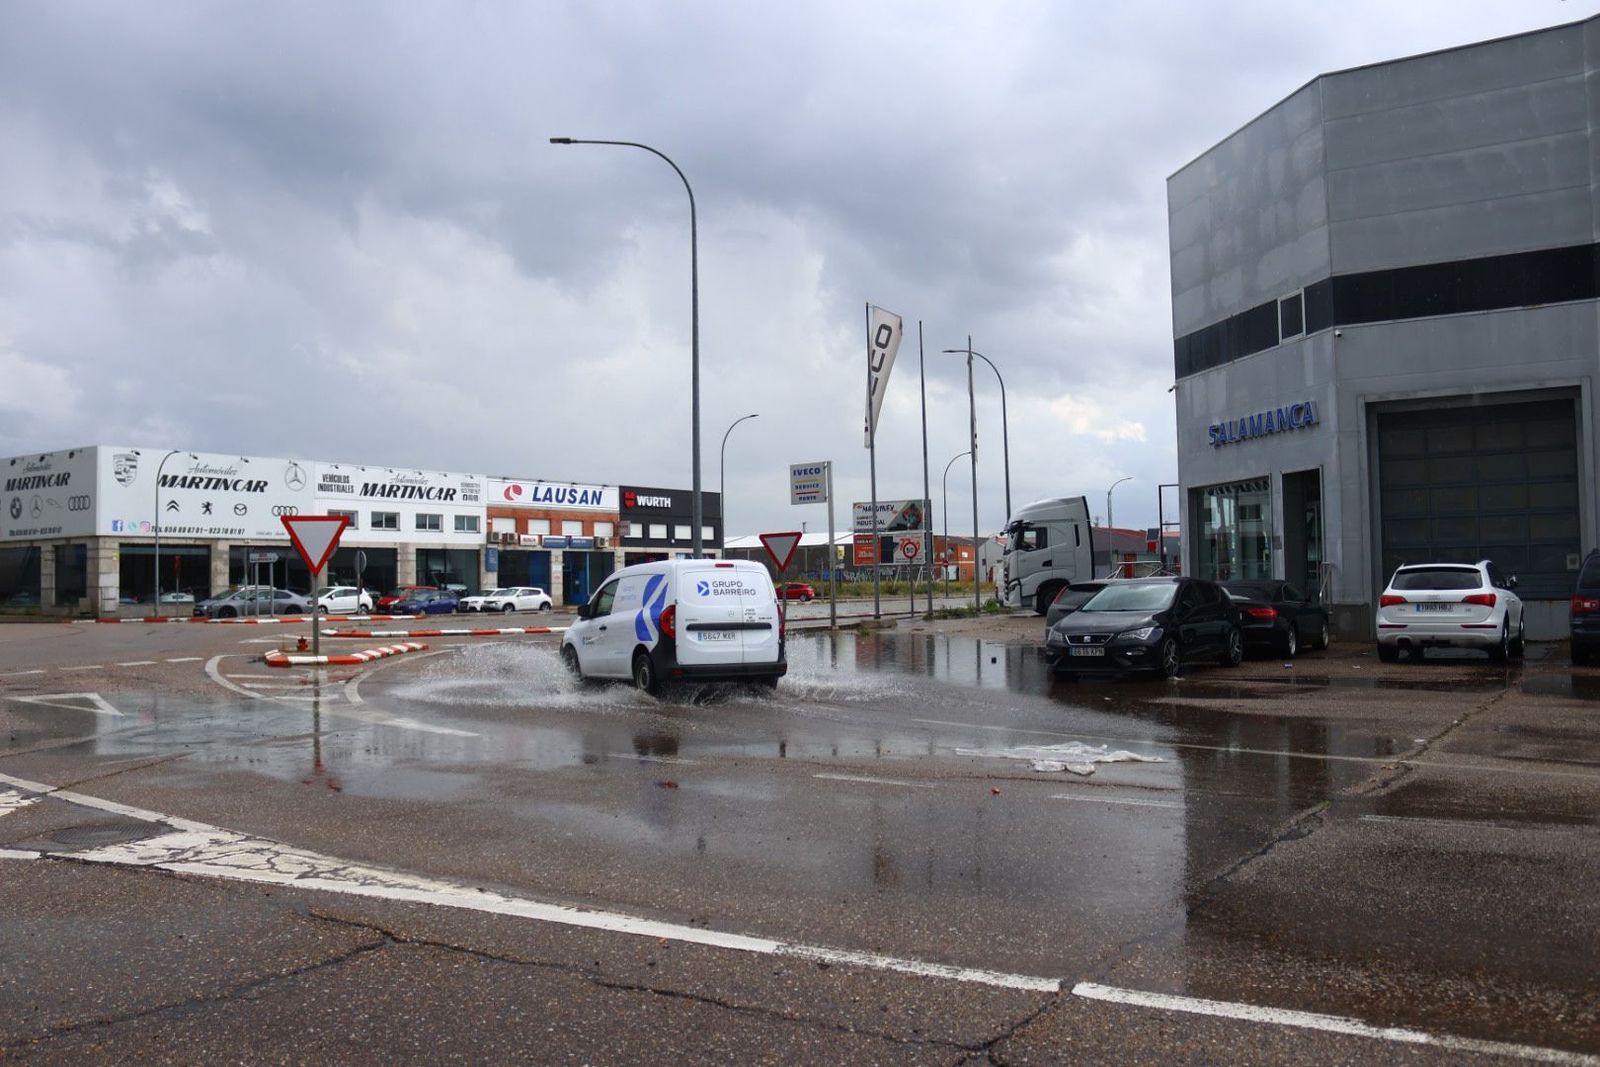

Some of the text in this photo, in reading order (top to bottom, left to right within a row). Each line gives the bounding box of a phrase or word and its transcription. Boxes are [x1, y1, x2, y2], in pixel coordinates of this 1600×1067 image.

[1208, 401, 1315, 447] SALAMANCA
[793, 467, 821, 476] IVECO
[5, 472, 70, 492] MARTINCAR
[157, 474, 269, 493] MARTINCAR
[359, 482, 457, 501] MARTINCAR
[532, 486, 603, 506] LAUSAN
[636, 495, 671, 508] WÜRTH
[712, 580, 743, 588] GRUPO
[713, 588, 757, 596] BARREIRO
